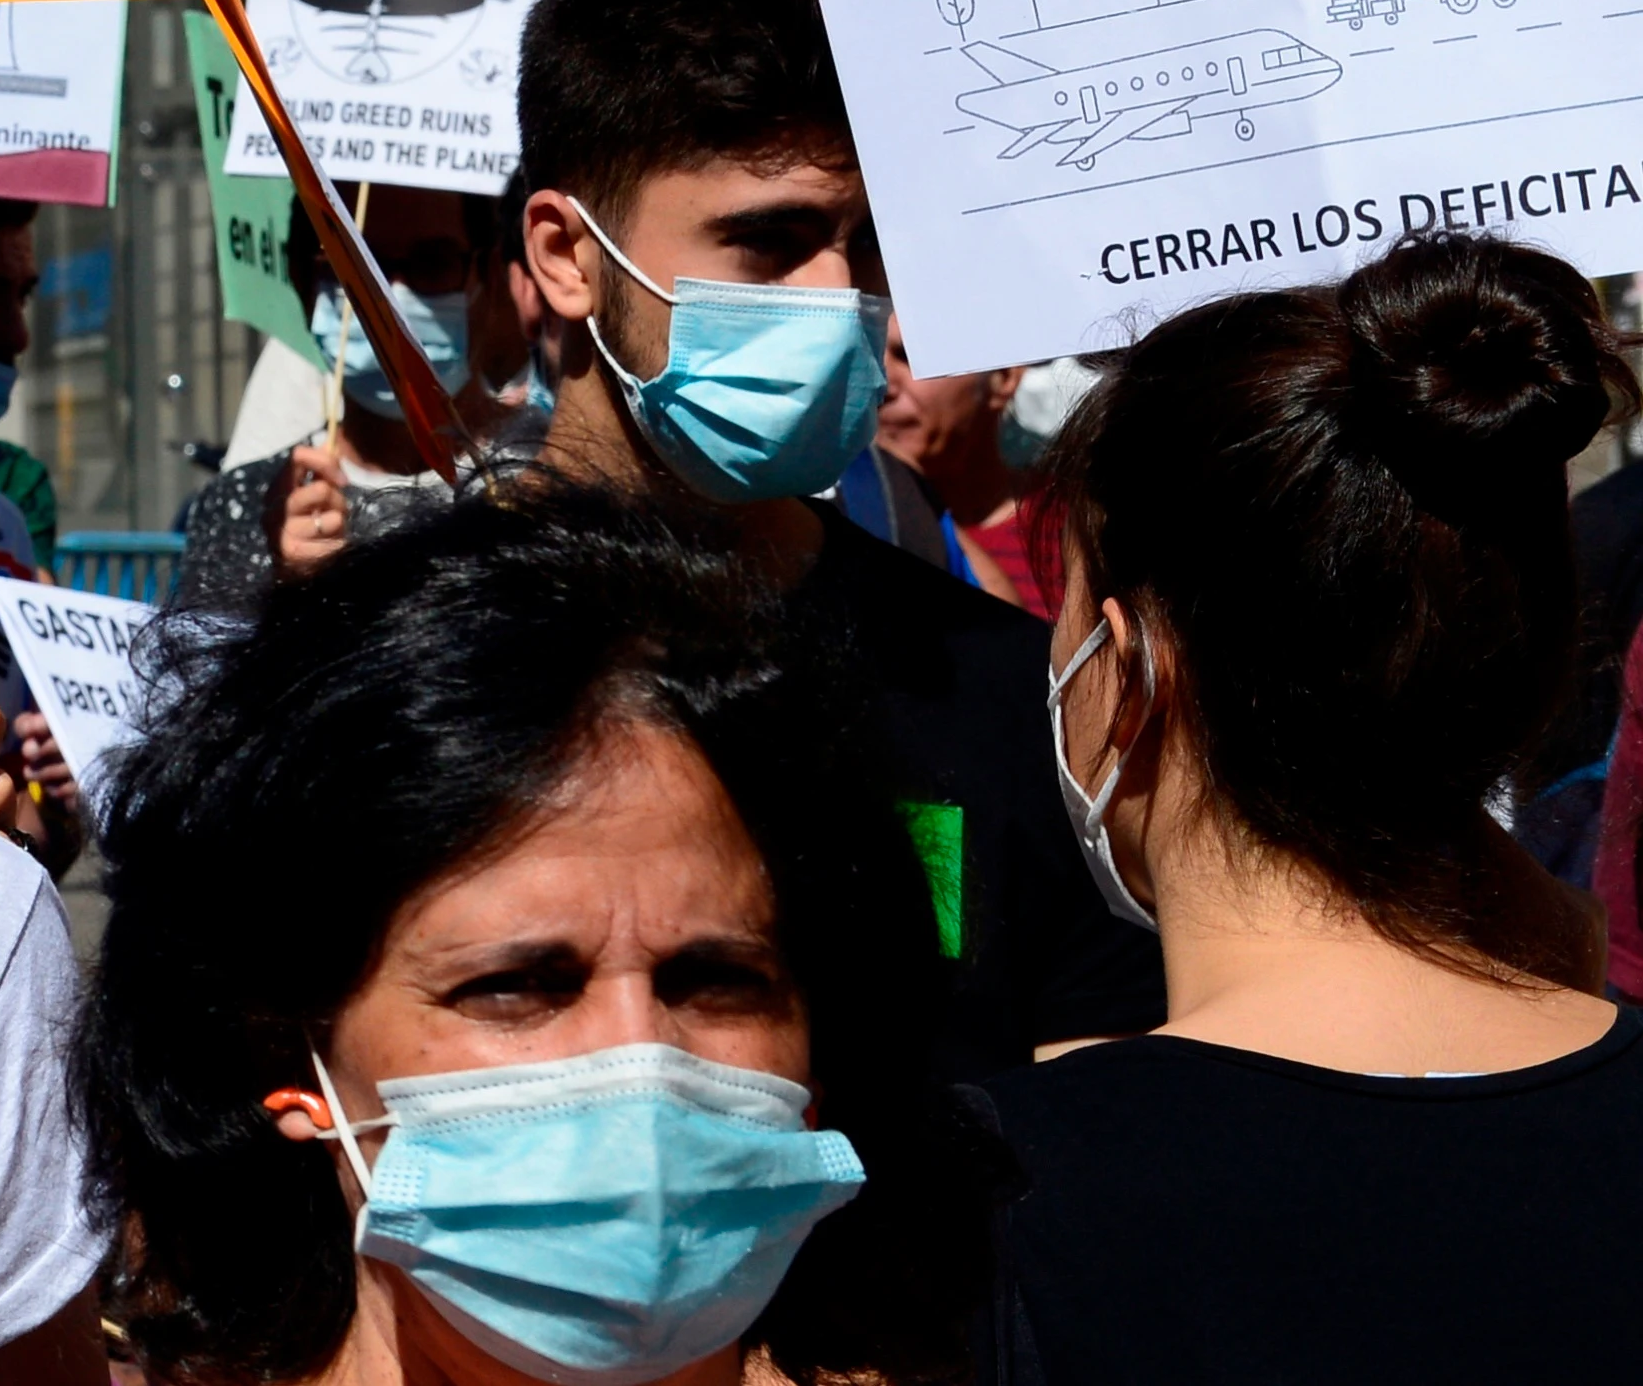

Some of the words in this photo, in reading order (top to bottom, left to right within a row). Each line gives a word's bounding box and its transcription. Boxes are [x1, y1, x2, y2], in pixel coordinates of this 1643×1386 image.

[339, 100, 412, 128] GREED
[420, 108, 492, 136] RUINS
[331, 136, 375, 161] AND
[385, 140, 427, 166] THE
[1102, 218, 1283, 285] CERRAR
[1292, 199, 1384, 254] LOS
[1399, 162, 1643, 235] DEFICITA
[51, 675, 119, 717] para
